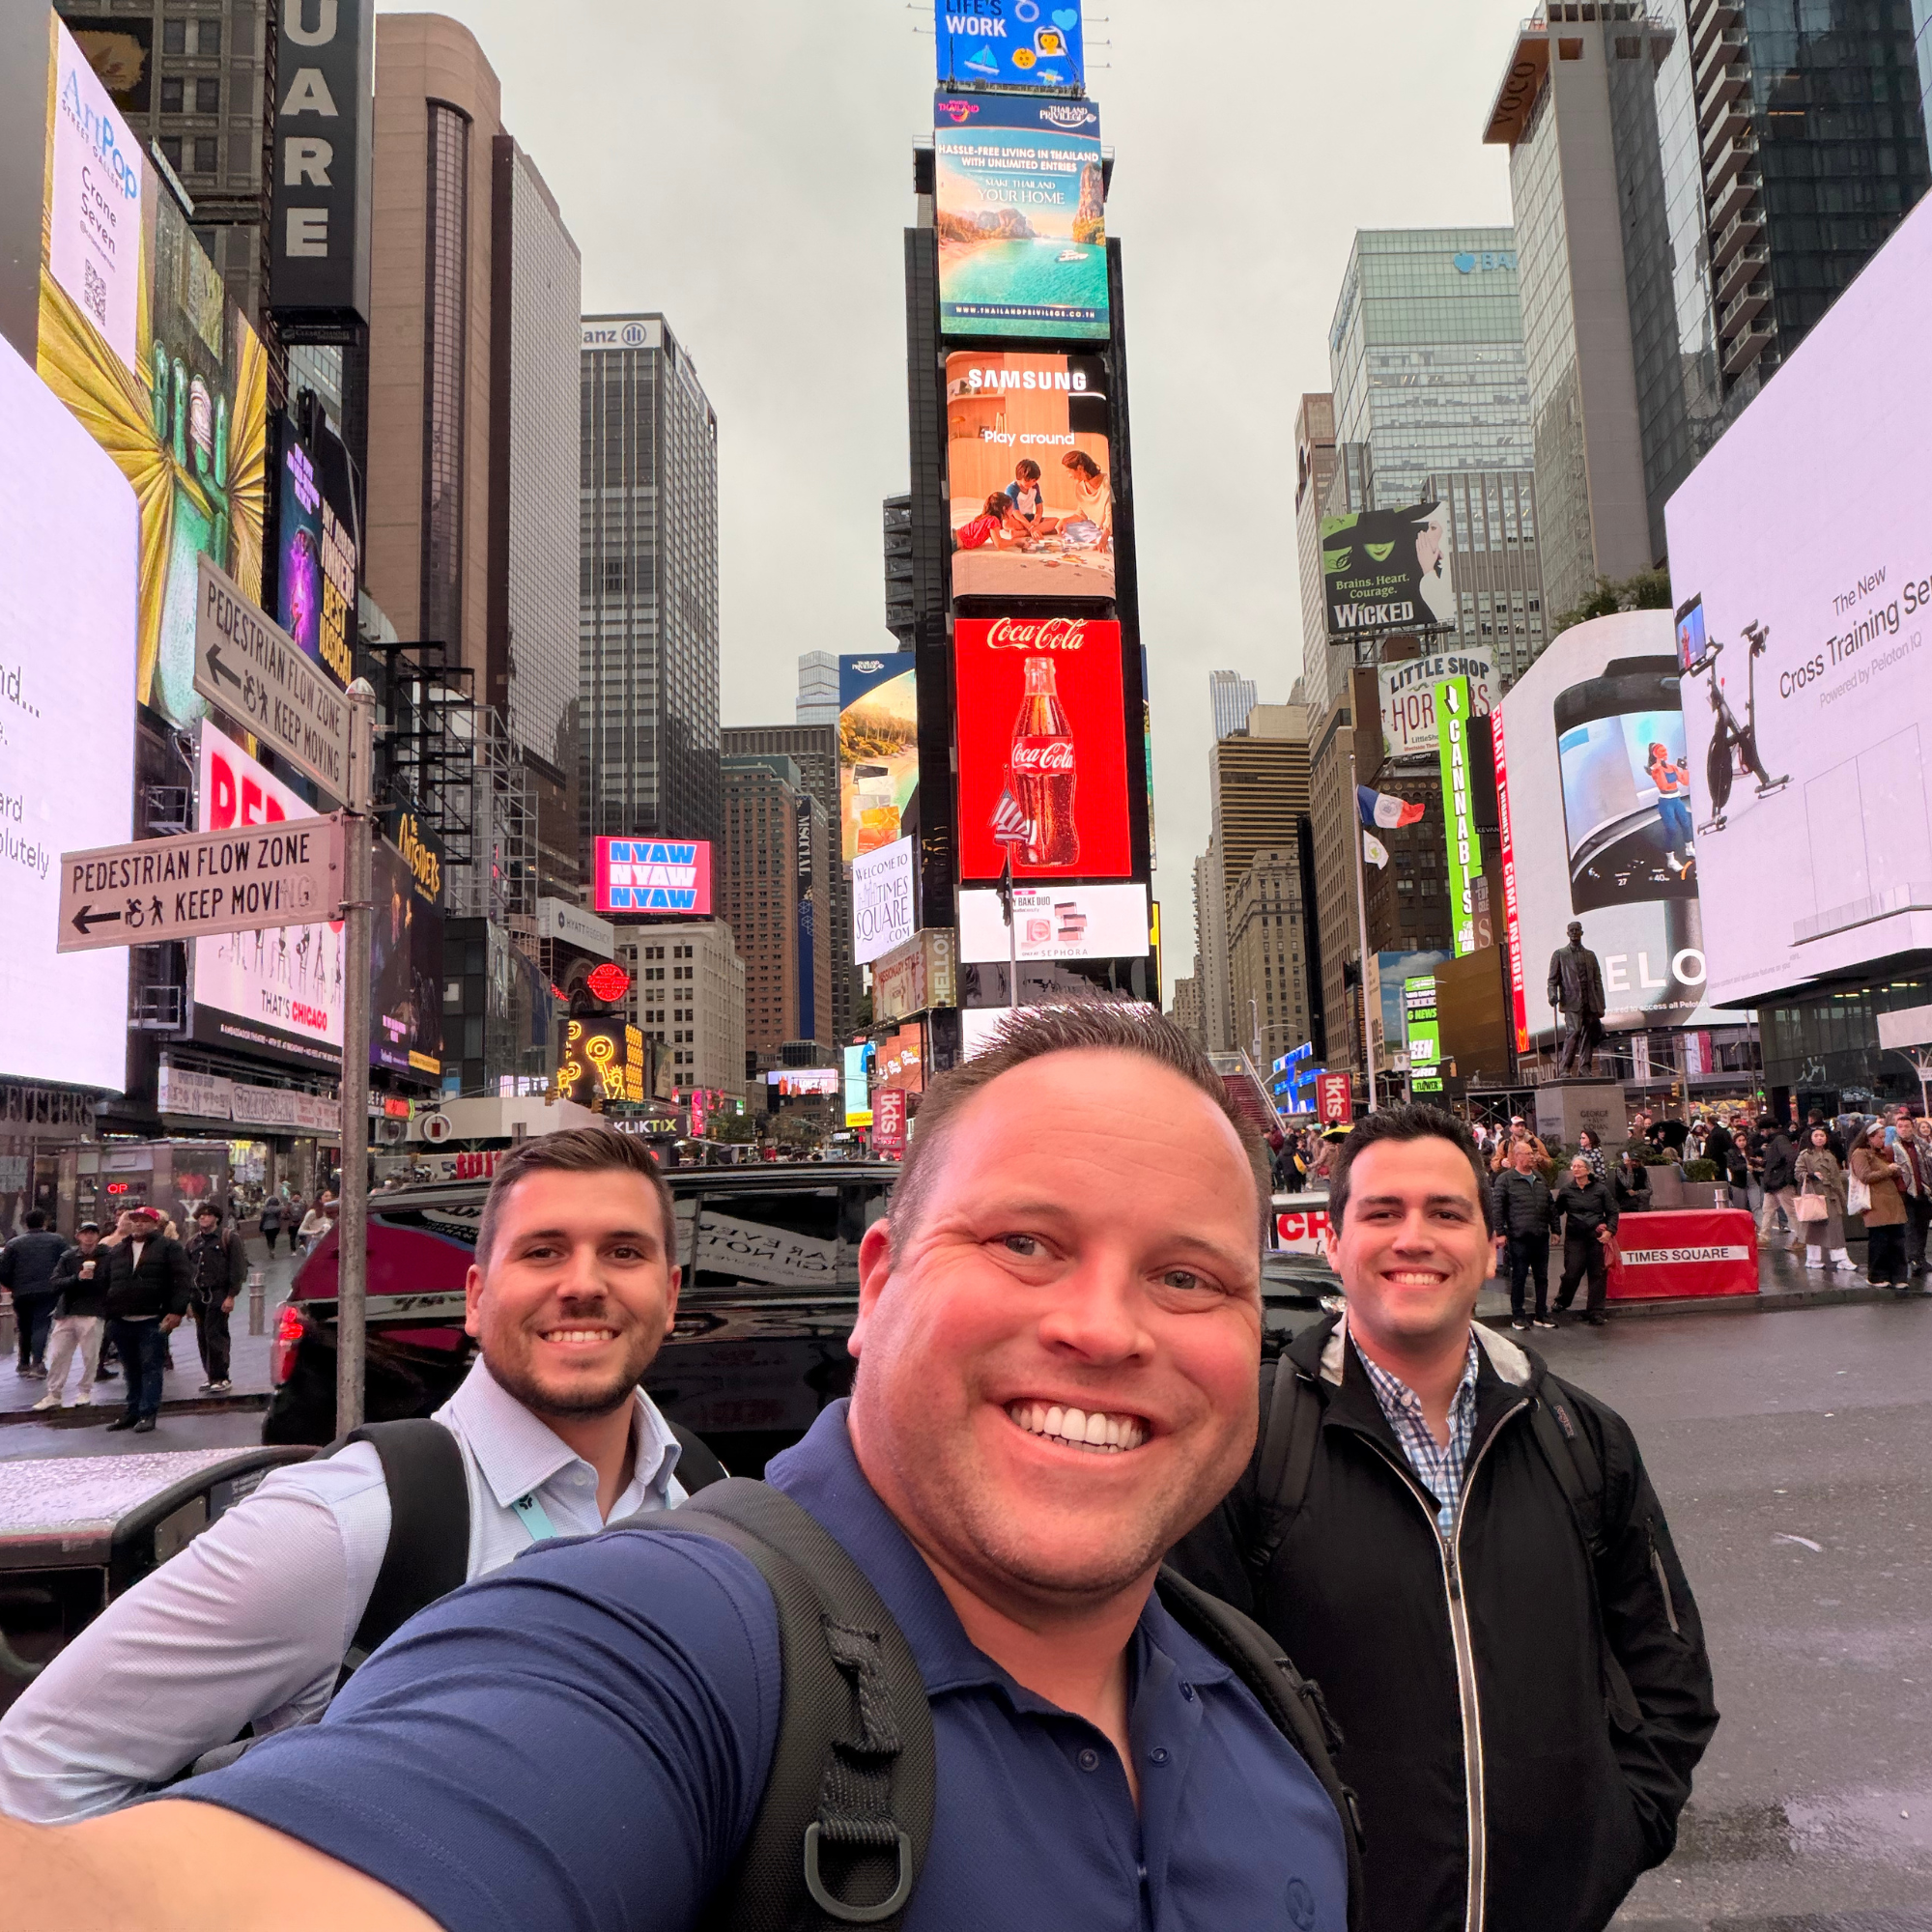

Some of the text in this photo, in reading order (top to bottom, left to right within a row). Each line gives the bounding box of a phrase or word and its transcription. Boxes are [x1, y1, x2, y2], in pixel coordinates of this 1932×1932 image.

[947, 0, 1002, 15] LIFE'S
[945, 14, 1008, 38] WORK
[938, 102, 980, 113] THAILAND
[1039, 109, 1084, 122] PRIVILEGE
[1049, 105, 1088, 115] THAILAND
[63, 68, 138, 200] ArtPop
[280, 0, 338, 258] UARE
[939, 144, 1098, 162] HASSLE-FREE LIVING IN THAILAND
[962, 156, 1077, 172] WITH UNLIMITED ENTRIES
[81, 165, 118, 228] Crane
[978, 188, 1065, 205] YOUR HOME
[1013, 180, 1056, 189] THAILAND
[81, 192, 116, 255] Seven
[582, 329, 617, 344] anz
[968, 368, 1087, 390] SAMSUNG
[983, 430, 1075, 447] Play around
[1336, 573, 1410, 590] Brains. Heart.
[1350, 584, 1398, 600] Courage.
[1833, 565, 1887, 616] The New
[986, 617, 1089, 650] Coca-Cola
[206, 580, 342, 738] PEDESTRIAN FLOW ZONE
[1779, 653, 1825, 699] Cross
[1826, 597, 1901, 668] Training
[1391, 657, 1490, 696] LITTLE SHOP
[1819, 631, 1922, 709] Powered by Peloton IQ
[273, 696, 340, 783] KEEP MOVING
[1492, 703, 1505, 774] COLATE
[1449, 719, 1473, 916] CANNABIS
[71, 832, 310, 894] PEDESTRIAN FLOW ZONE
[610, 840, 697, 866] NYAW
[610, 864, 697, 887] NYAW
[855, 852, 908, 883] WELCOME TO
[610, 886, 698, 910] NYAW
[876, 875, 909, 900] TIMES
[1504, 861, 1518, 919] COME
[175, 886, 223, 923] KEEP
[1018, 896, 1036, 907] BAKE
[1037, 896, 1051, 906] DUO
[566, 918, 585, 934] HYATT
[856, 895, 910, 943] SQUARE
[886, 924, 911, 944] .COM
[905, 952, 921, 972] STYLE
[933, 934, 952, 1004] HELLO!
[1508, 920, 1524, 992] INSIDE!
[1605, 949, 1706, 993] ELO
[261, 989, 328, 1032] THAT'S CHICAGO
[1415, 1008, 1437, 1020] NEWS
[1639, 1003, 1667, 1011] access
[1668, 1001, 1679, 1009] all
[1680, 1000, 1709, 1009] Peloton
[1324, 1076, 1346, 1119] tkts
[880, 1093, 900, 1135] tkts
[1580, 1109, 1609, 1118] GEORGE
[1277, 1210, 1330, 1241] CH
[1626, 1247, 1729, 1263] TIMES SQUARE
